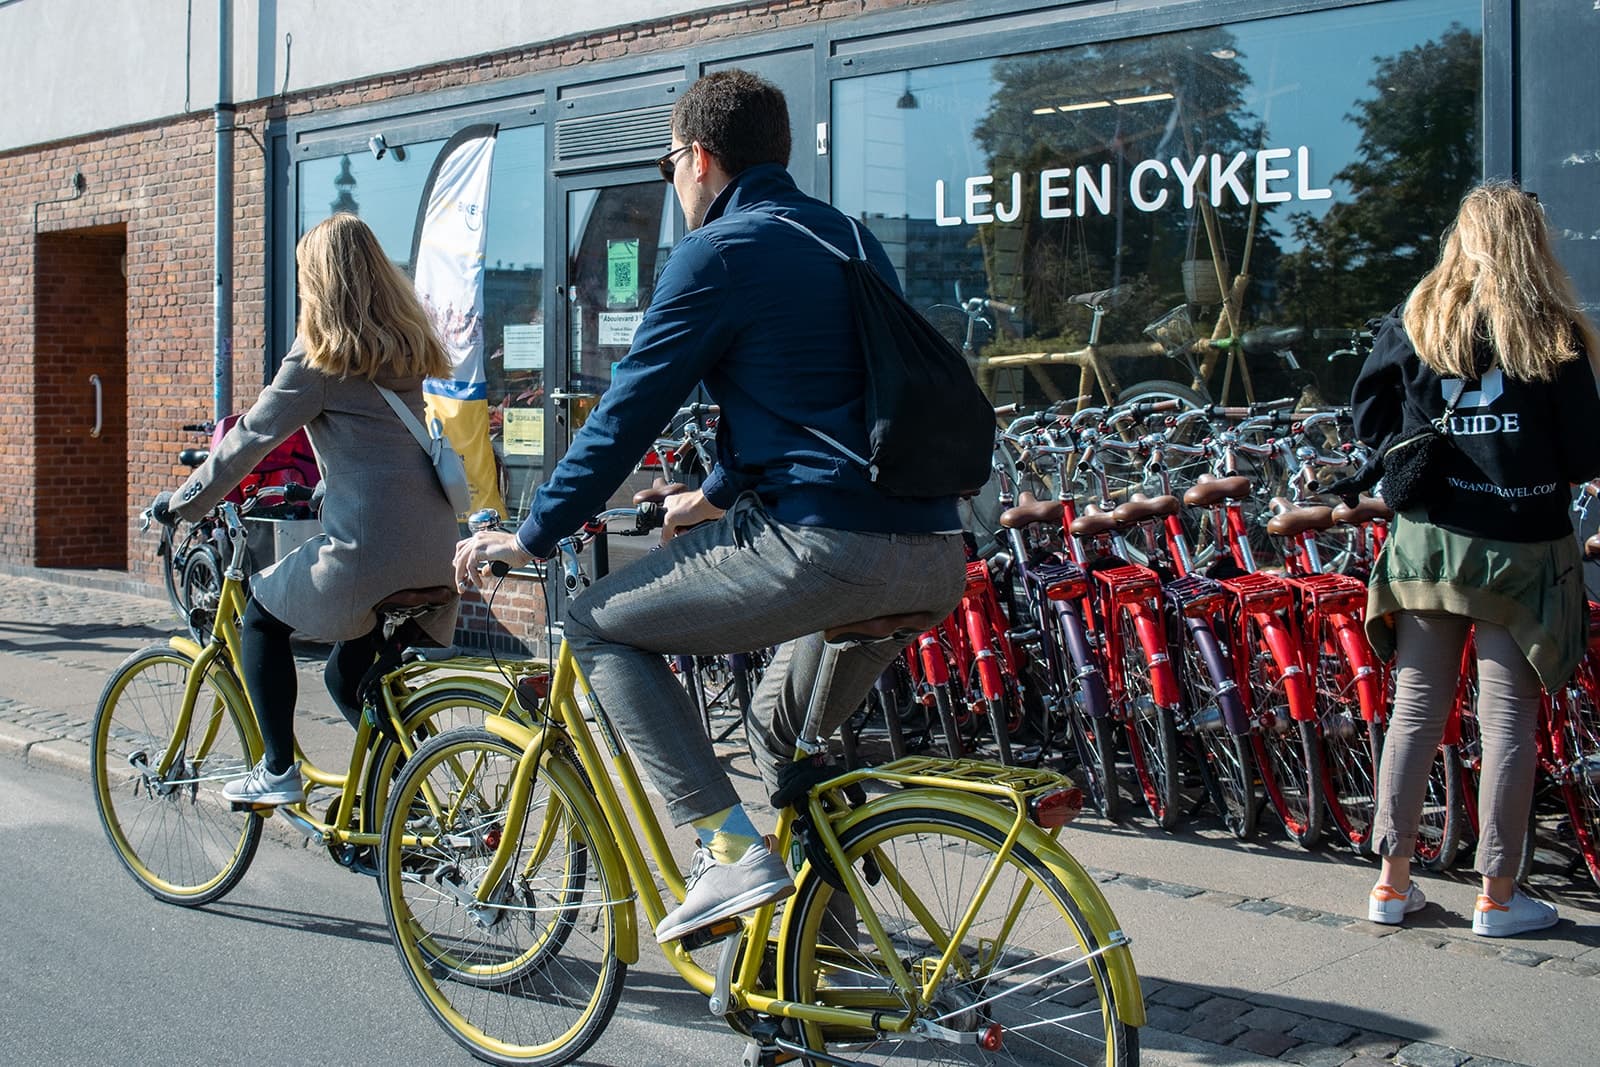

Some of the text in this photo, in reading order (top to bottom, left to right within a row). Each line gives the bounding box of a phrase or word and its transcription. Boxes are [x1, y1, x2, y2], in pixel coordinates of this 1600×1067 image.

[935, 145, 1333, 227] LEJ EN CYKEL
